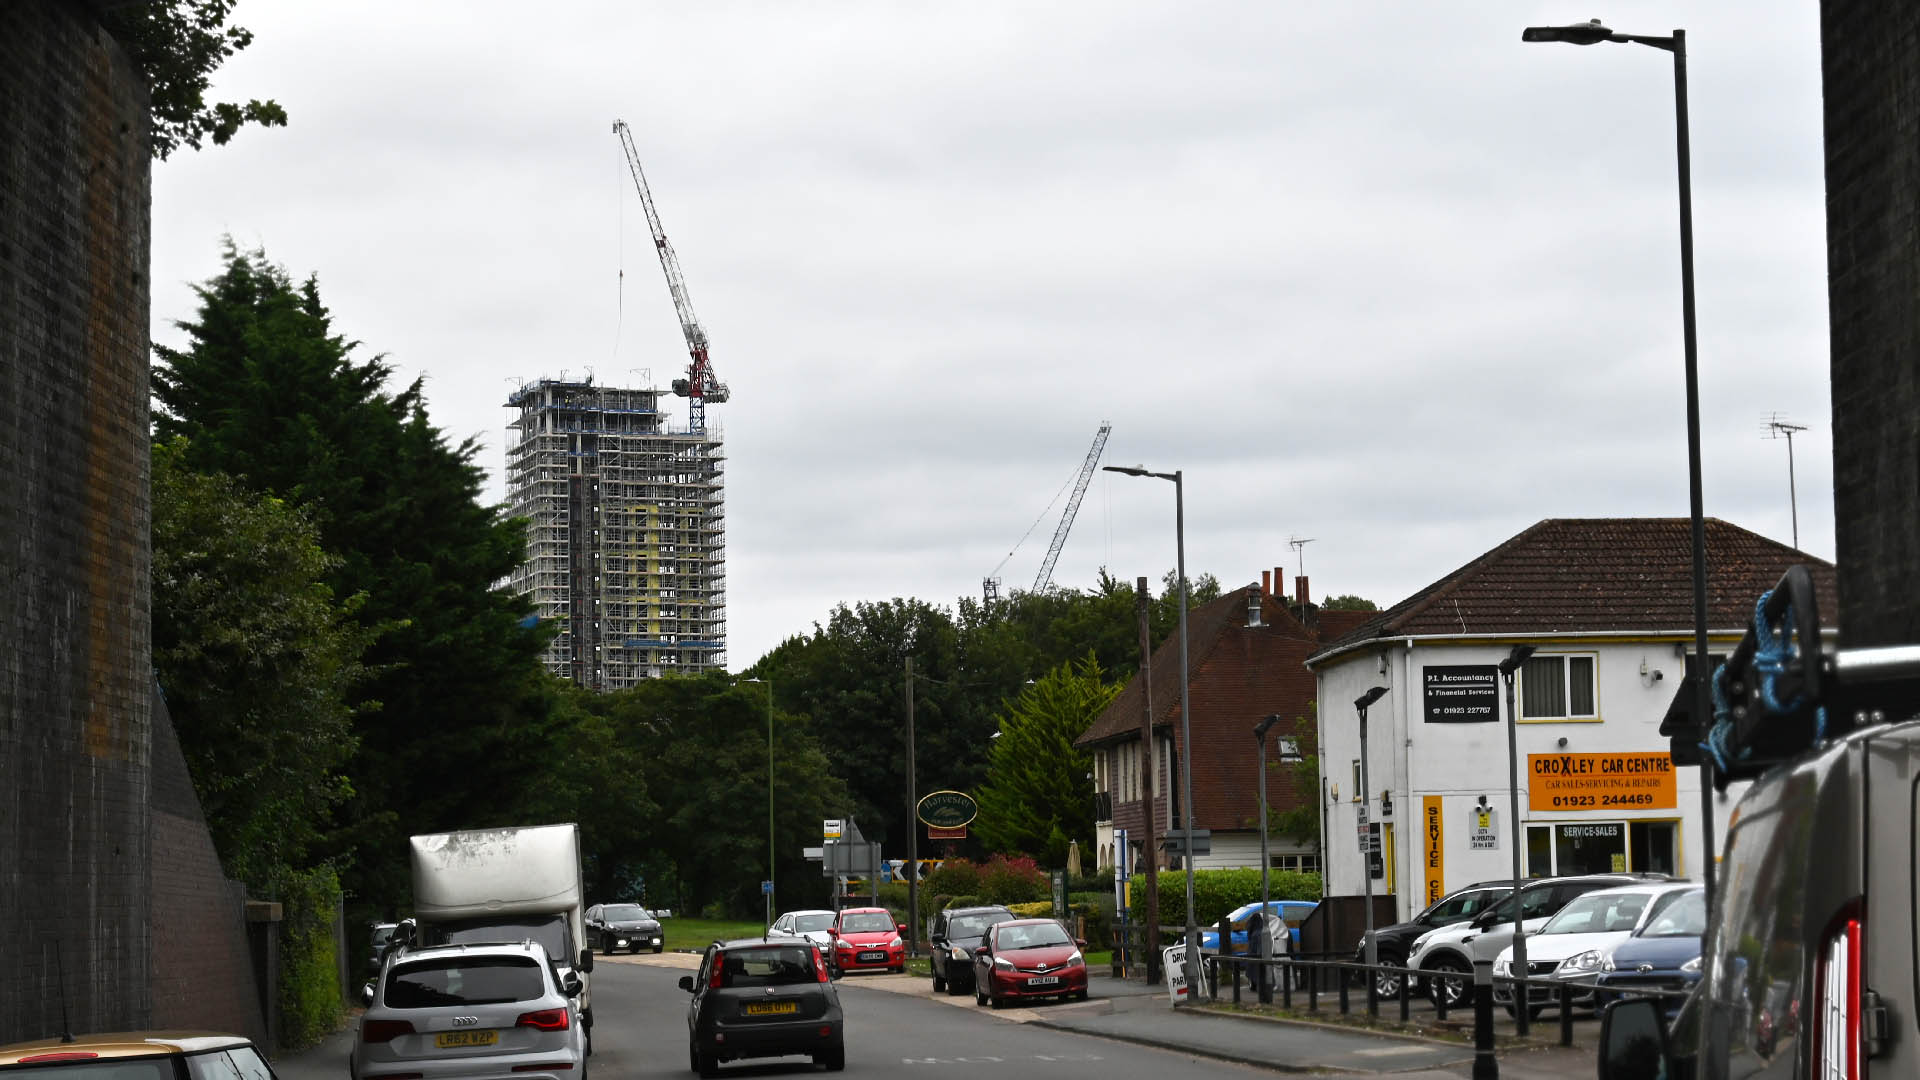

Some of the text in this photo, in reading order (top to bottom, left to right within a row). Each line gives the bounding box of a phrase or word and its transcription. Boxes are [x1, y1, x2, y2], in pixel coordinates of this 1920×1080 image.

[1442, 674, 1494, 682] Accountancy
[1535, 756, 1670, 776] CROXLEY CAR CENTRE
[1545, 779, 1561, 790] CAR
[1632, 777, 1661, 788] REPAIRS
[1552, 794, 1653, 807] 01923 244469
[1428, 806, 1439, 868] SERVICE
[1563, 826, 1618, 838] SERVICE-SALES
